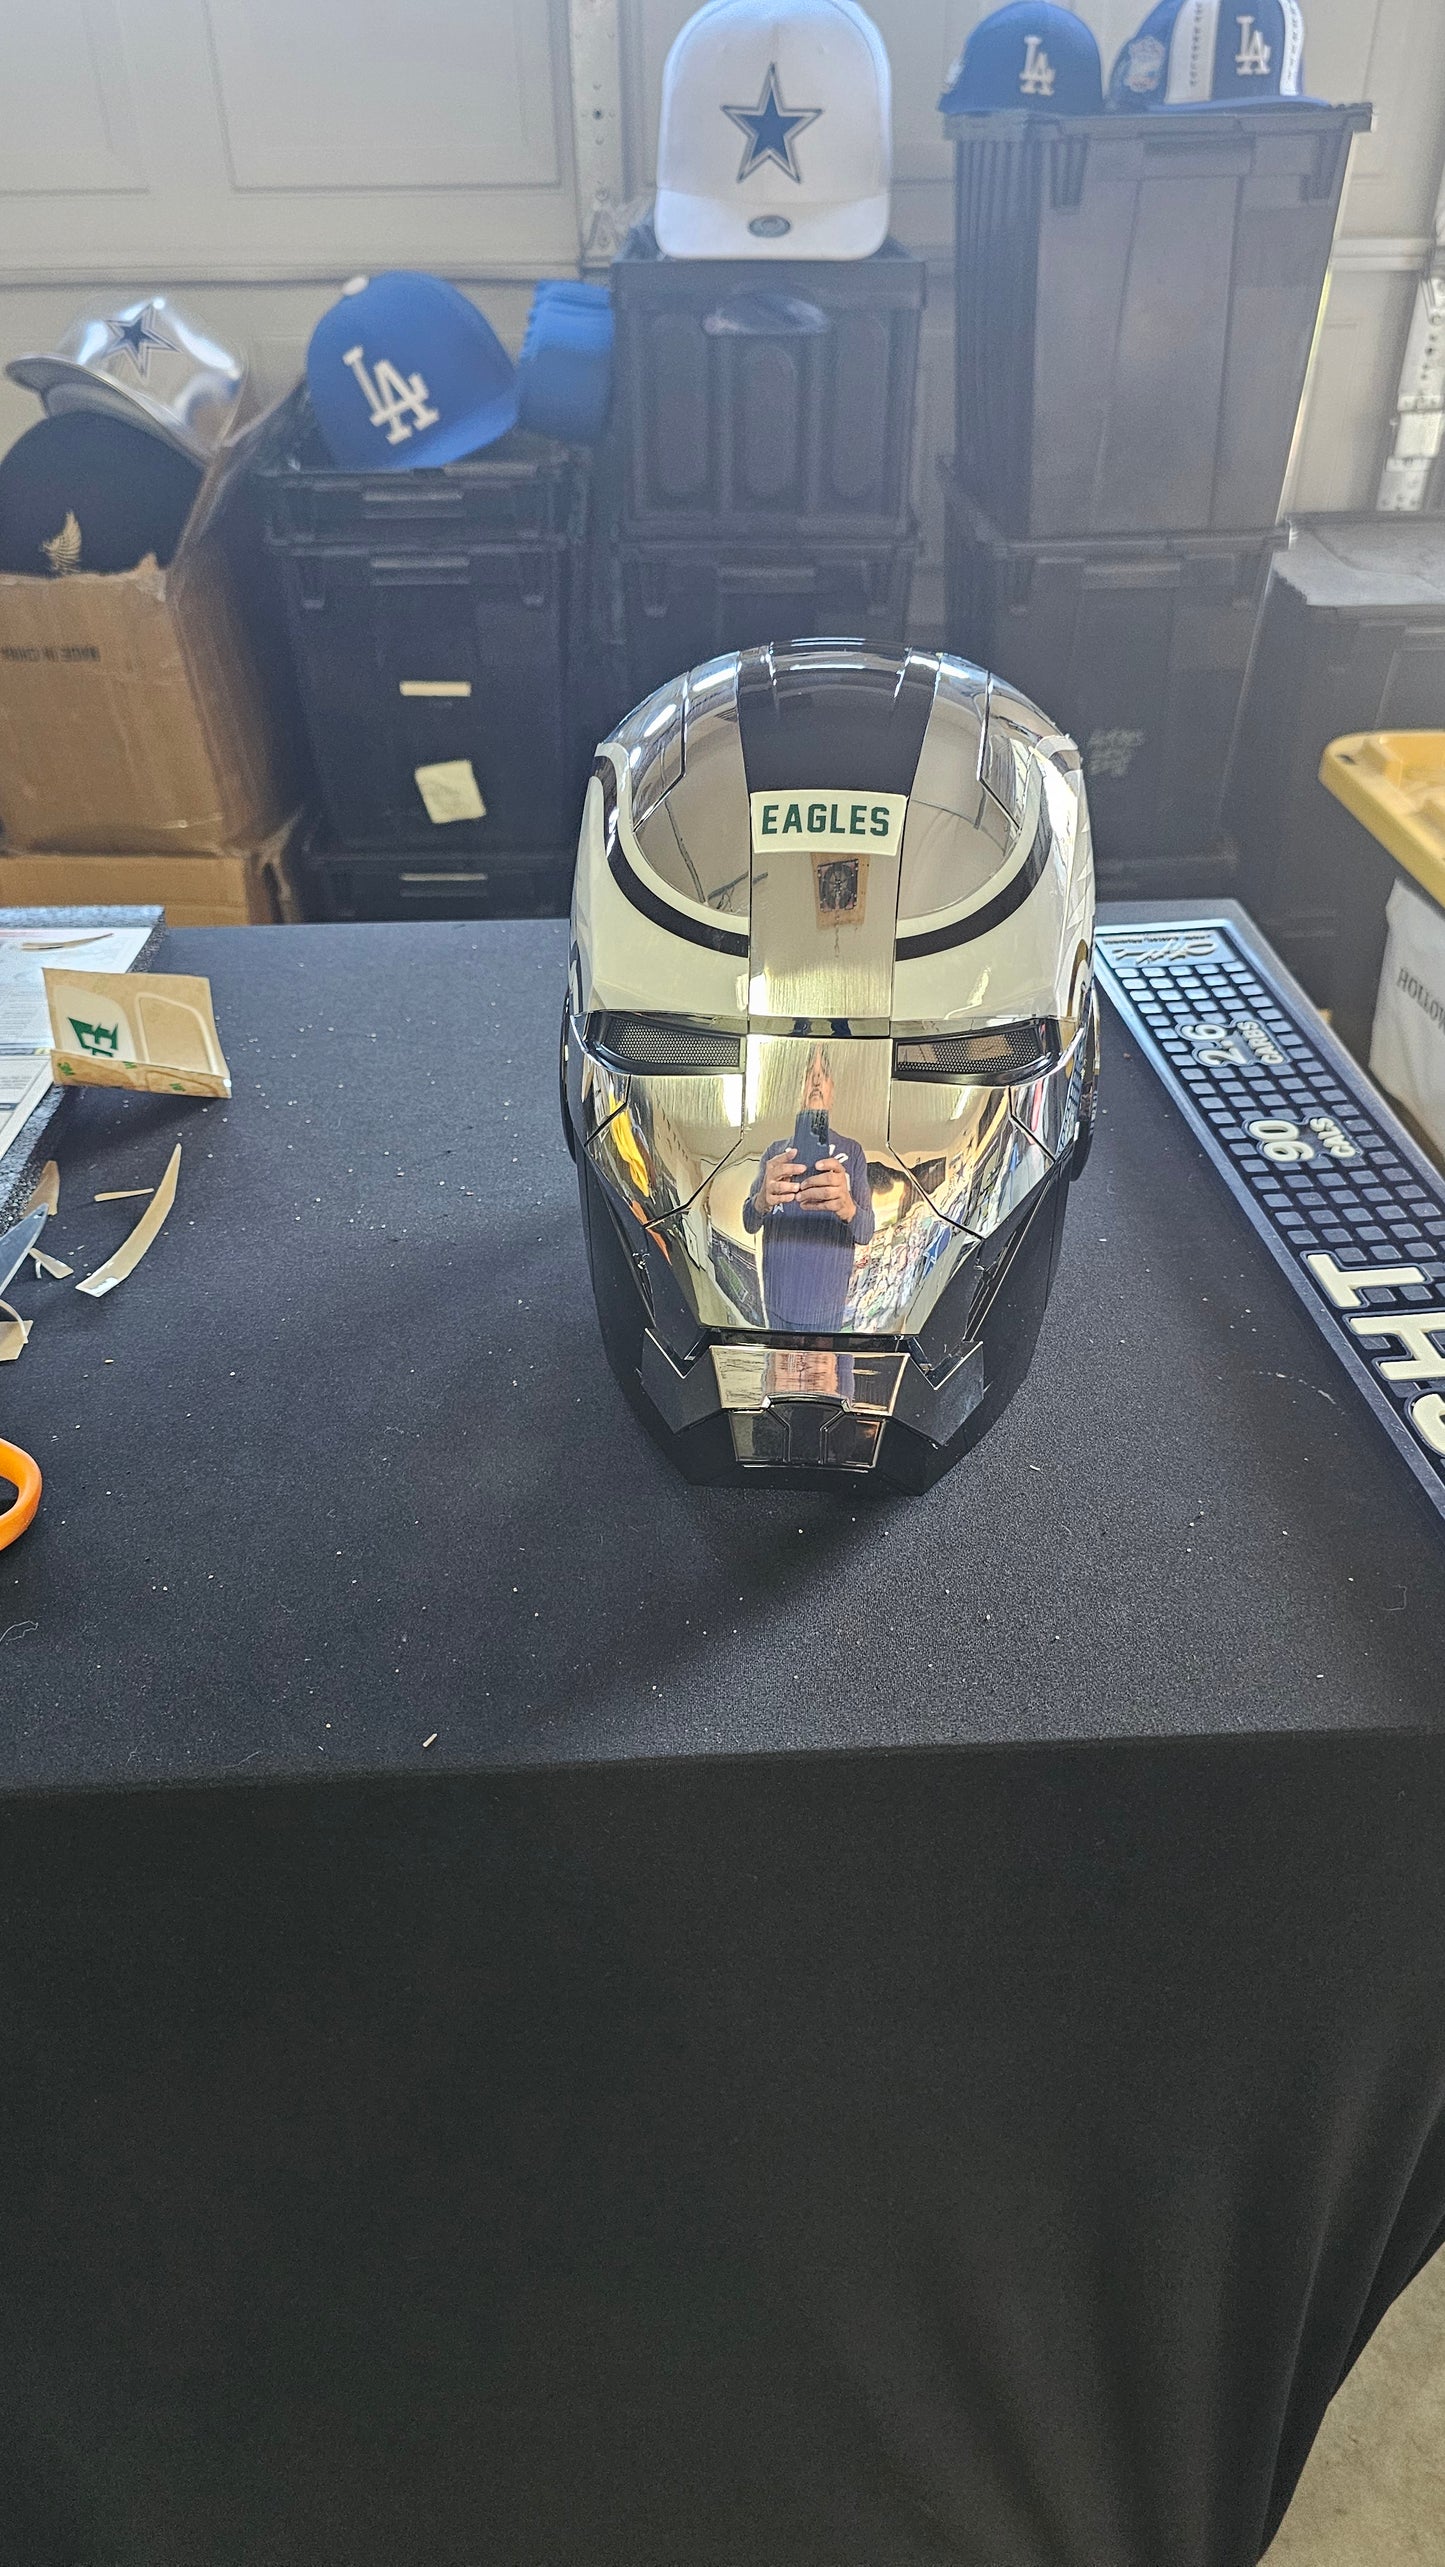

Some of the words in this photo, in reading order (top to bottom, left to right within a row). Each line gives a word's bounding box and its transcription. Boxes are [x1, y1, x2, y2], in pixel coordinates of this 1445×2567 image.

[1019, 35, 1056, 96] LA
[1235, 15, 1272, 76] LA
[342, 345, 440, 445] LA
[761, 803, 890, 837] EAGLES
[1180, 1023, 1248, 1066] 2.6
[1236, 1020, 1284, 1064] CARBS
[1248, 1119, 1315, 1161] 90
[1309, 1117, 1356, 1158] CALS
